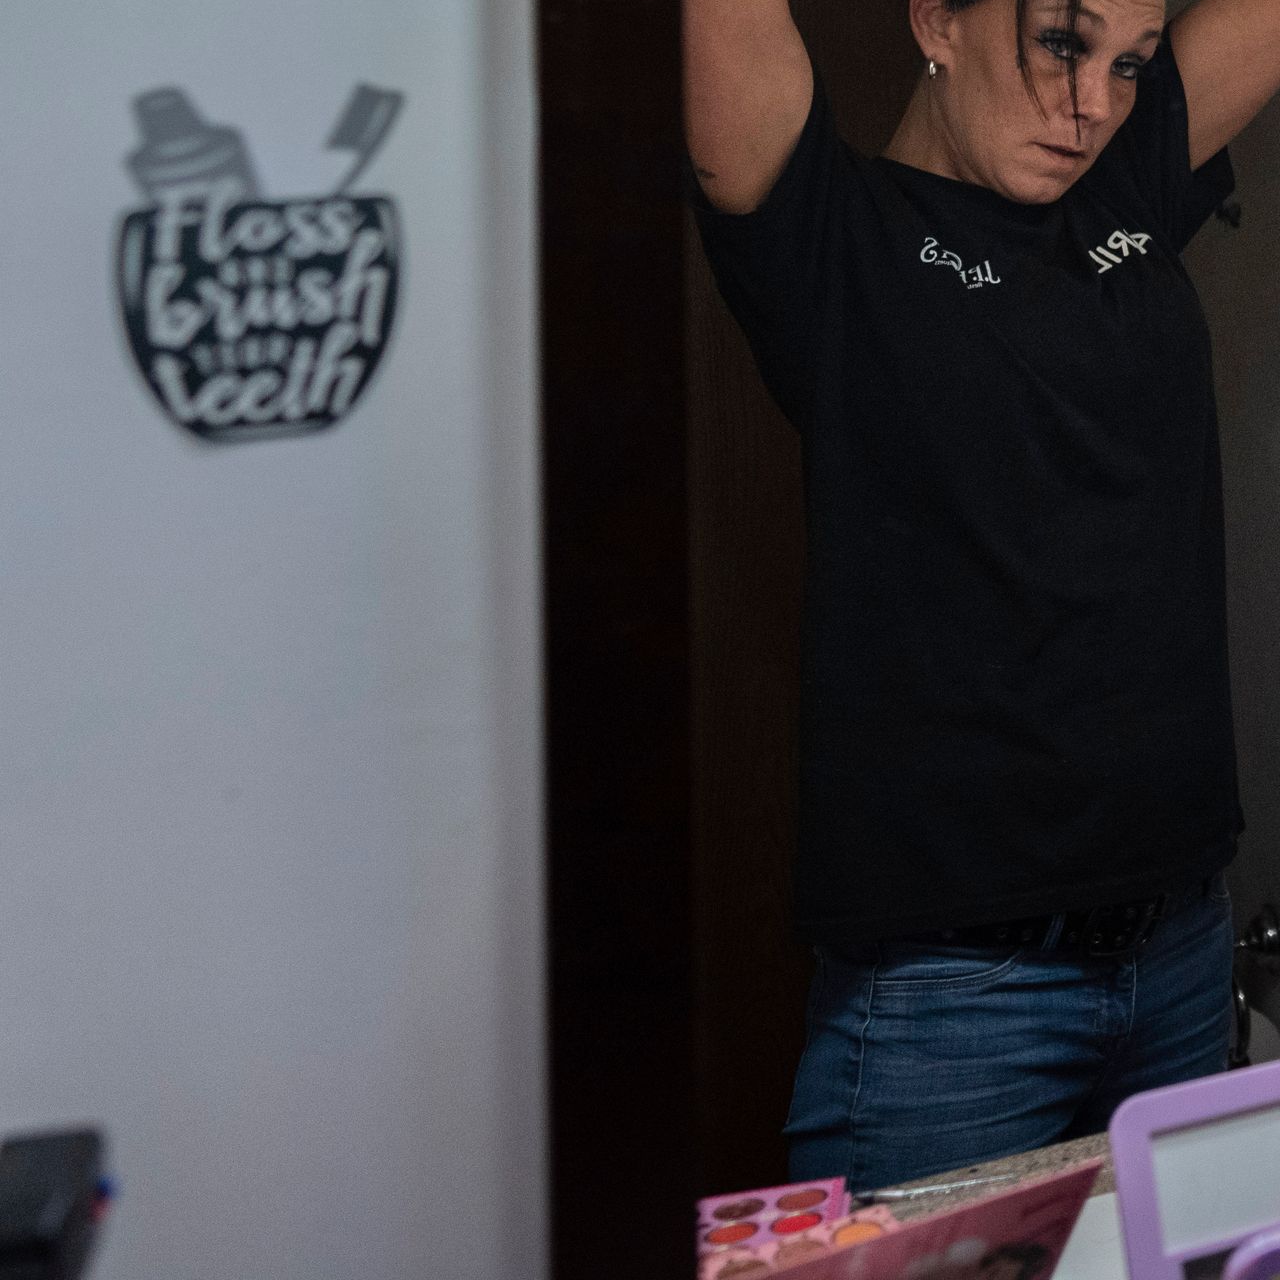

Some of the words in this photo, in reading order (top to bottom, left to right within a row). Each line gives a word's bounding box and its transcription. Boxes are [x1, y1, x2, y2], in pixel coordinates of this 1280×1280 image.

[151, 177, 357, 263] Floss
[144, 226, 390, 349] brush
[152, 321, 368, 424] teeth
